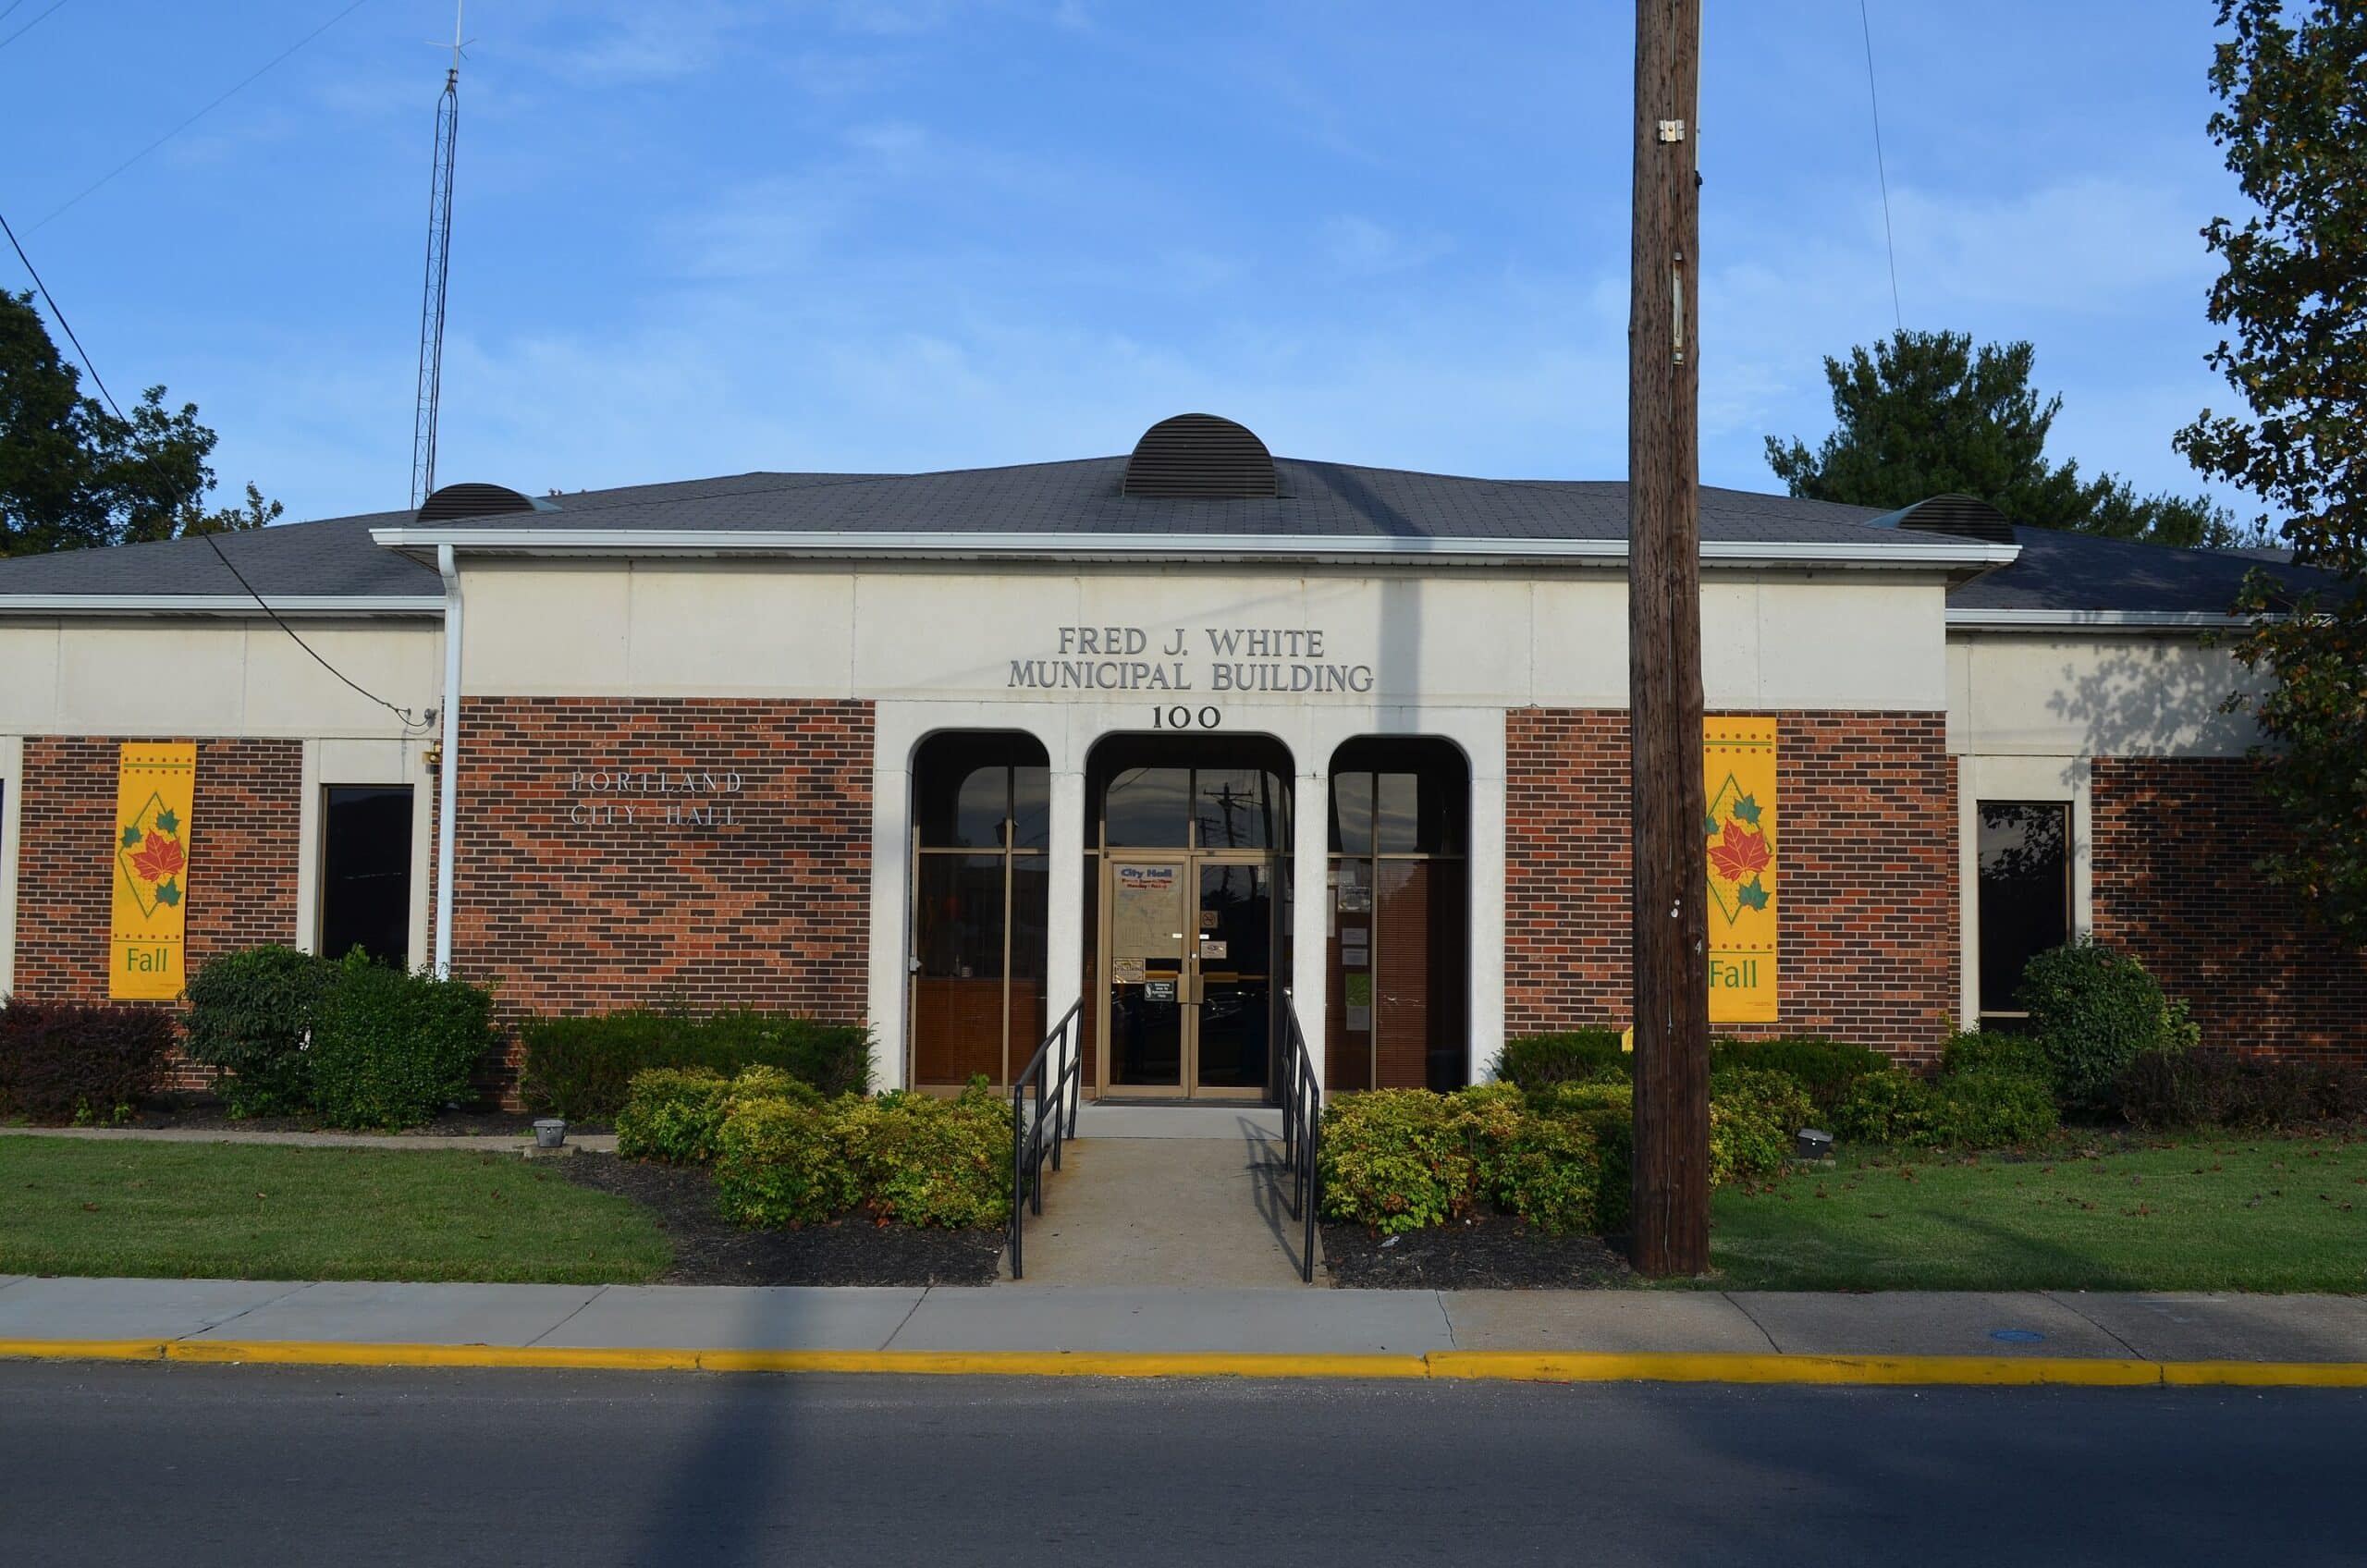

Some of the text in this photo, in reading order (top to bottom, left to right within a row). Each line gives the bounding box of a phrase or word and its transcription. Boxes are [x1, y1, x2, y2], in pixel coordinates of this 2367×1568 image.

[1058, 627, 1326, 657] FRED J. WHITE
[1007, 660, 1374, 692] MUNICIPAL BUILDING
[1153, 705, 1221, 729] 100
[571, 771, 741, 792] PORTLAND
[570, 804, 741, 826] CITY HALL
[1121, 868, 1172, 878] City Hall
[127, 948, 167, 972] Fall
[1709, 959, 1758, 988] Fall
